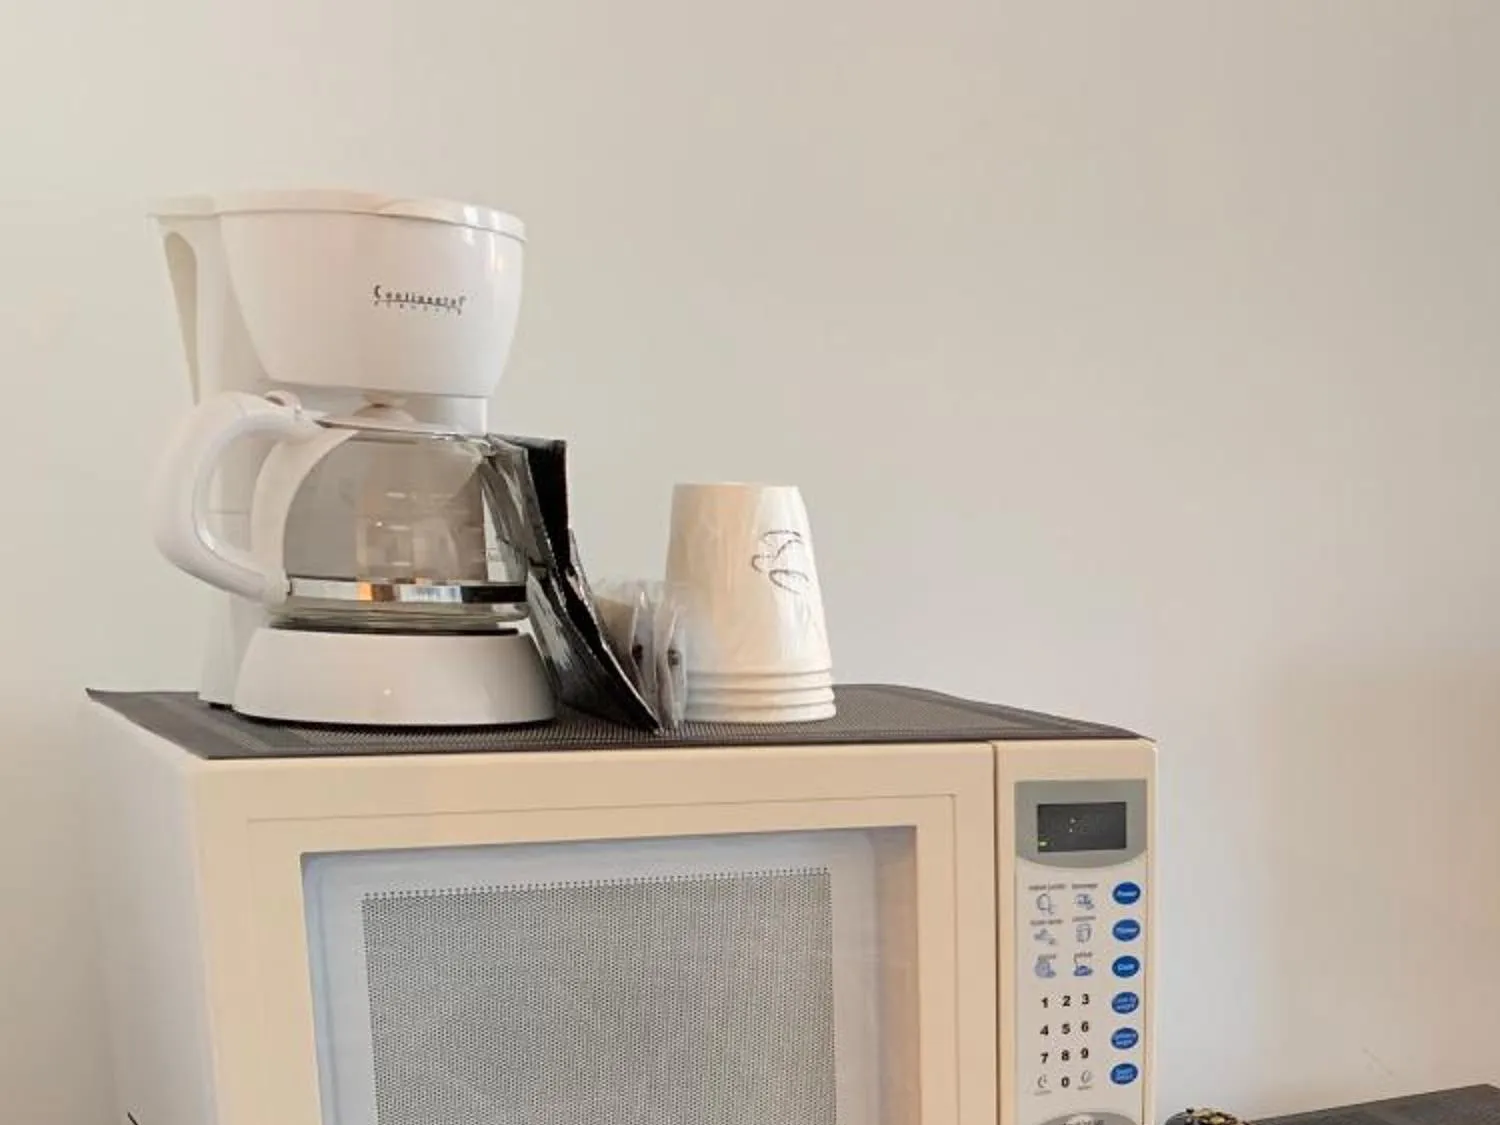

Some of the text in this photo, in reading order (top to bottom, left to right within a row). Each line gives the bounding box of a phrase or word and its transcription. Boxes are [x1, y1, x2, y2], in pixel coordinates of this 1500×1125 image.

[1041, 993, 1090, 1009] 1 2 3
[1040, 1021, 1089, 1036] 4 5 6
[1040, 1047, 1089, 1064] 7 8 9
[1061, 1076, 1070, 1088] 0
